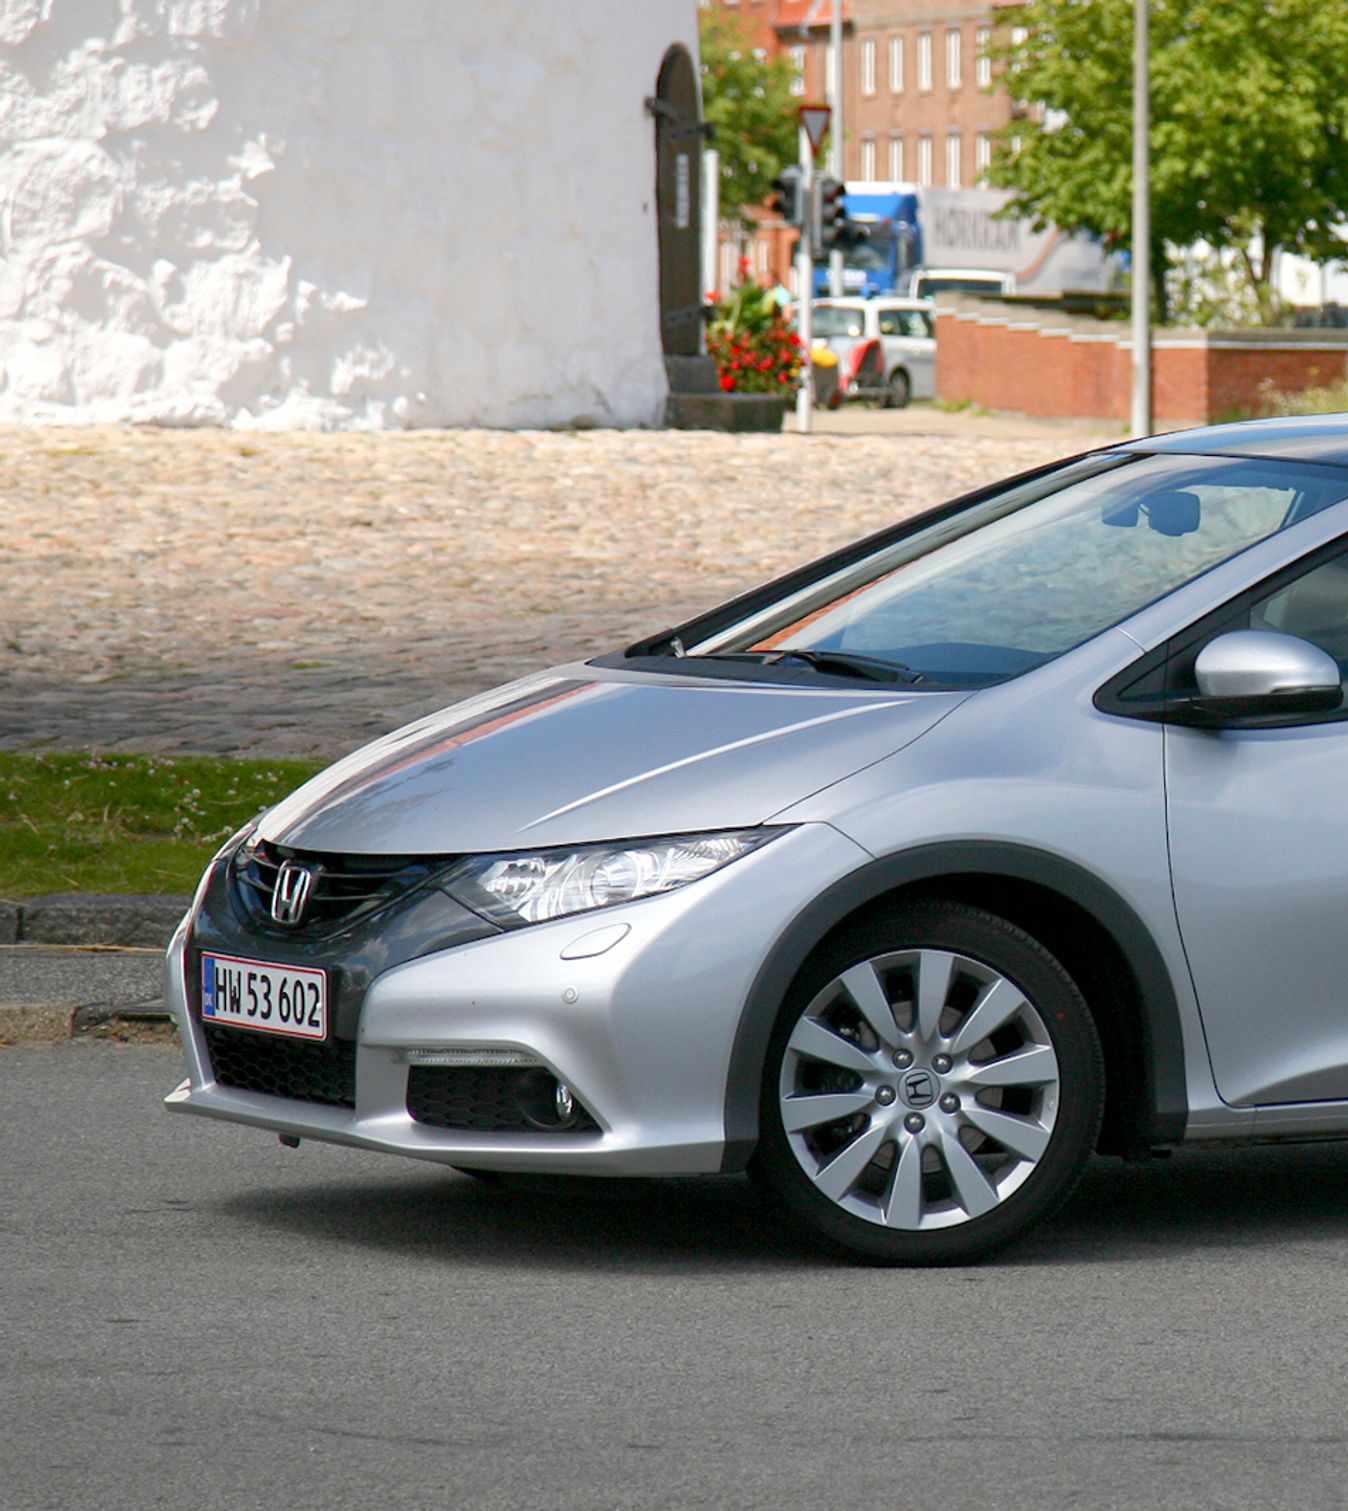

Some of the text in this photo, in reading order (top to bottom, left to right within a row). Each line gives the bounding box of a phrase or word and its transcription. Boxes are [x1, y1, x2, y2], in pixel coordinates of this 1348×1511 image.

[215, 966, 321, 1029] HW 53 602
